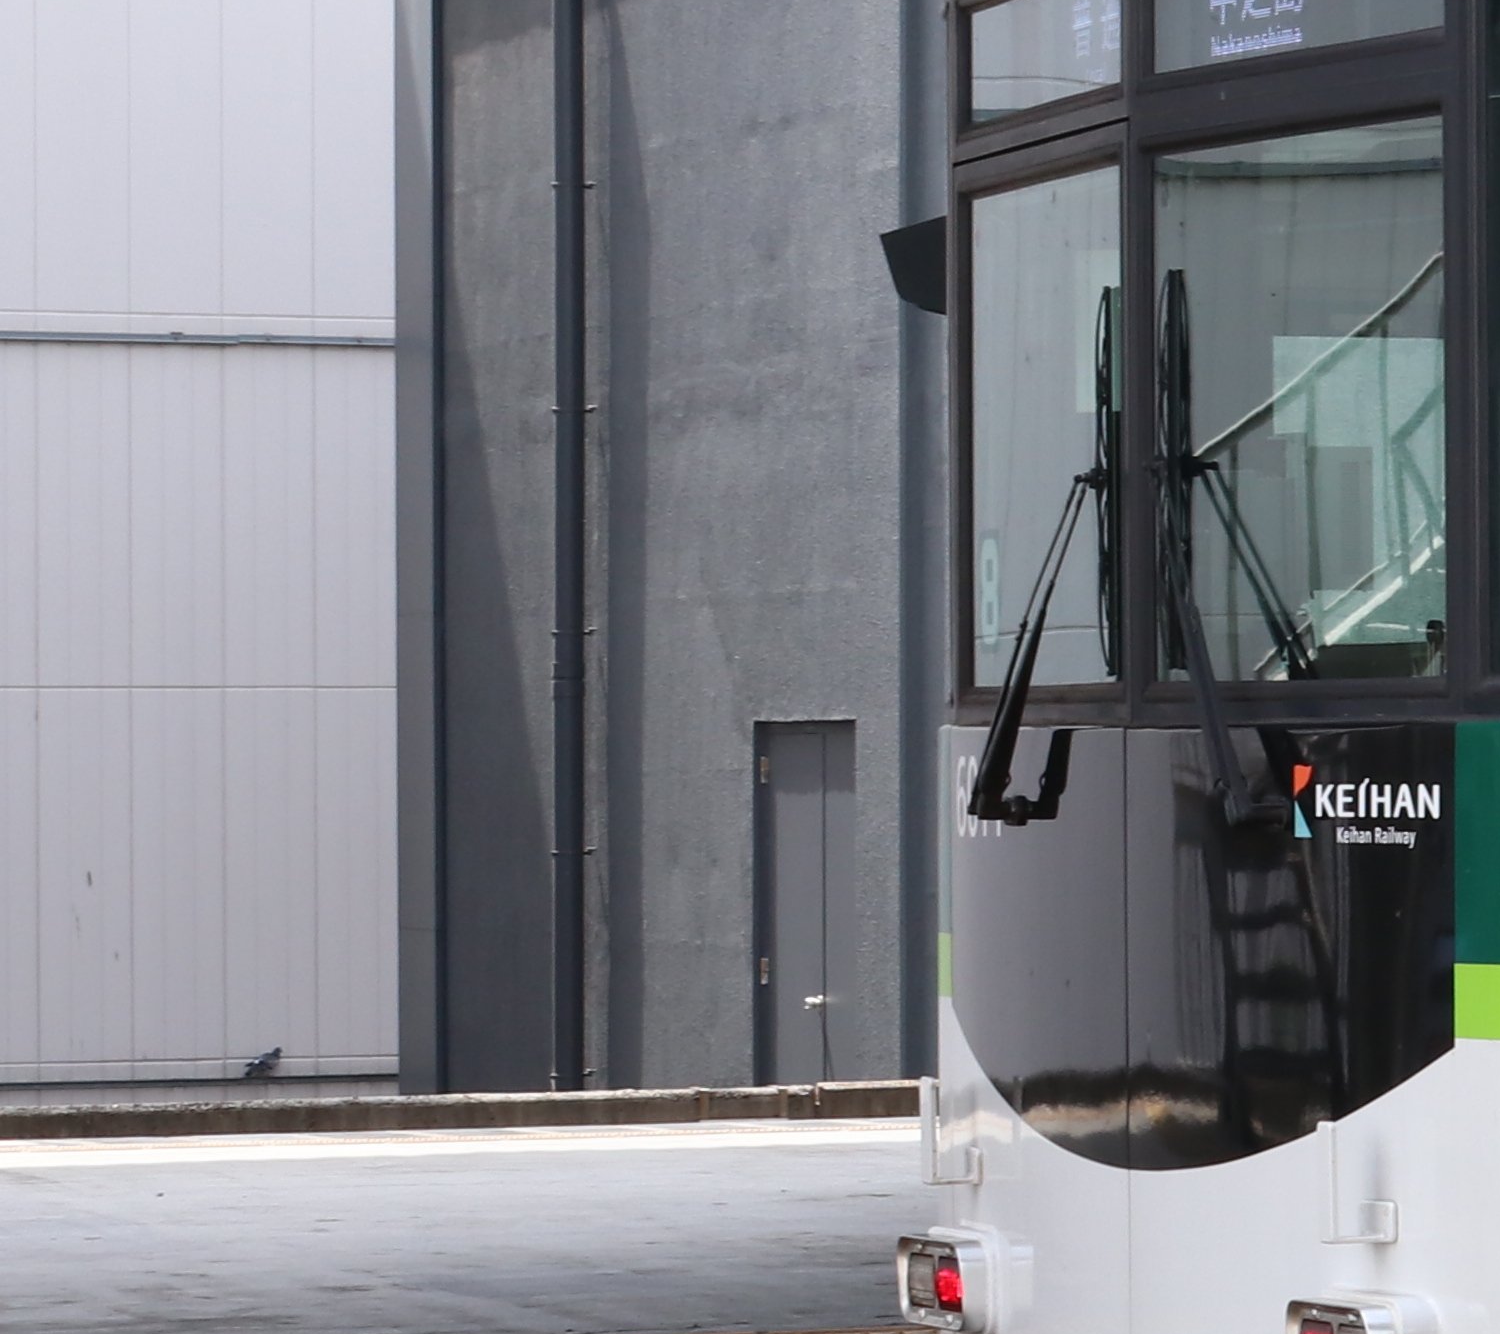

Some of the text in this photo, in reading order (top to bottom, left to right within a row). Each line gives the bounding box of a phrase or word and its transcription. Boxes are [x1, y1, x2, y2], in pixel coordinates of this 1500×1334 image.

[1315, 778, 1440, 819] KEIHAN
[1336, 826, 1416, 849] Keihan Railway
